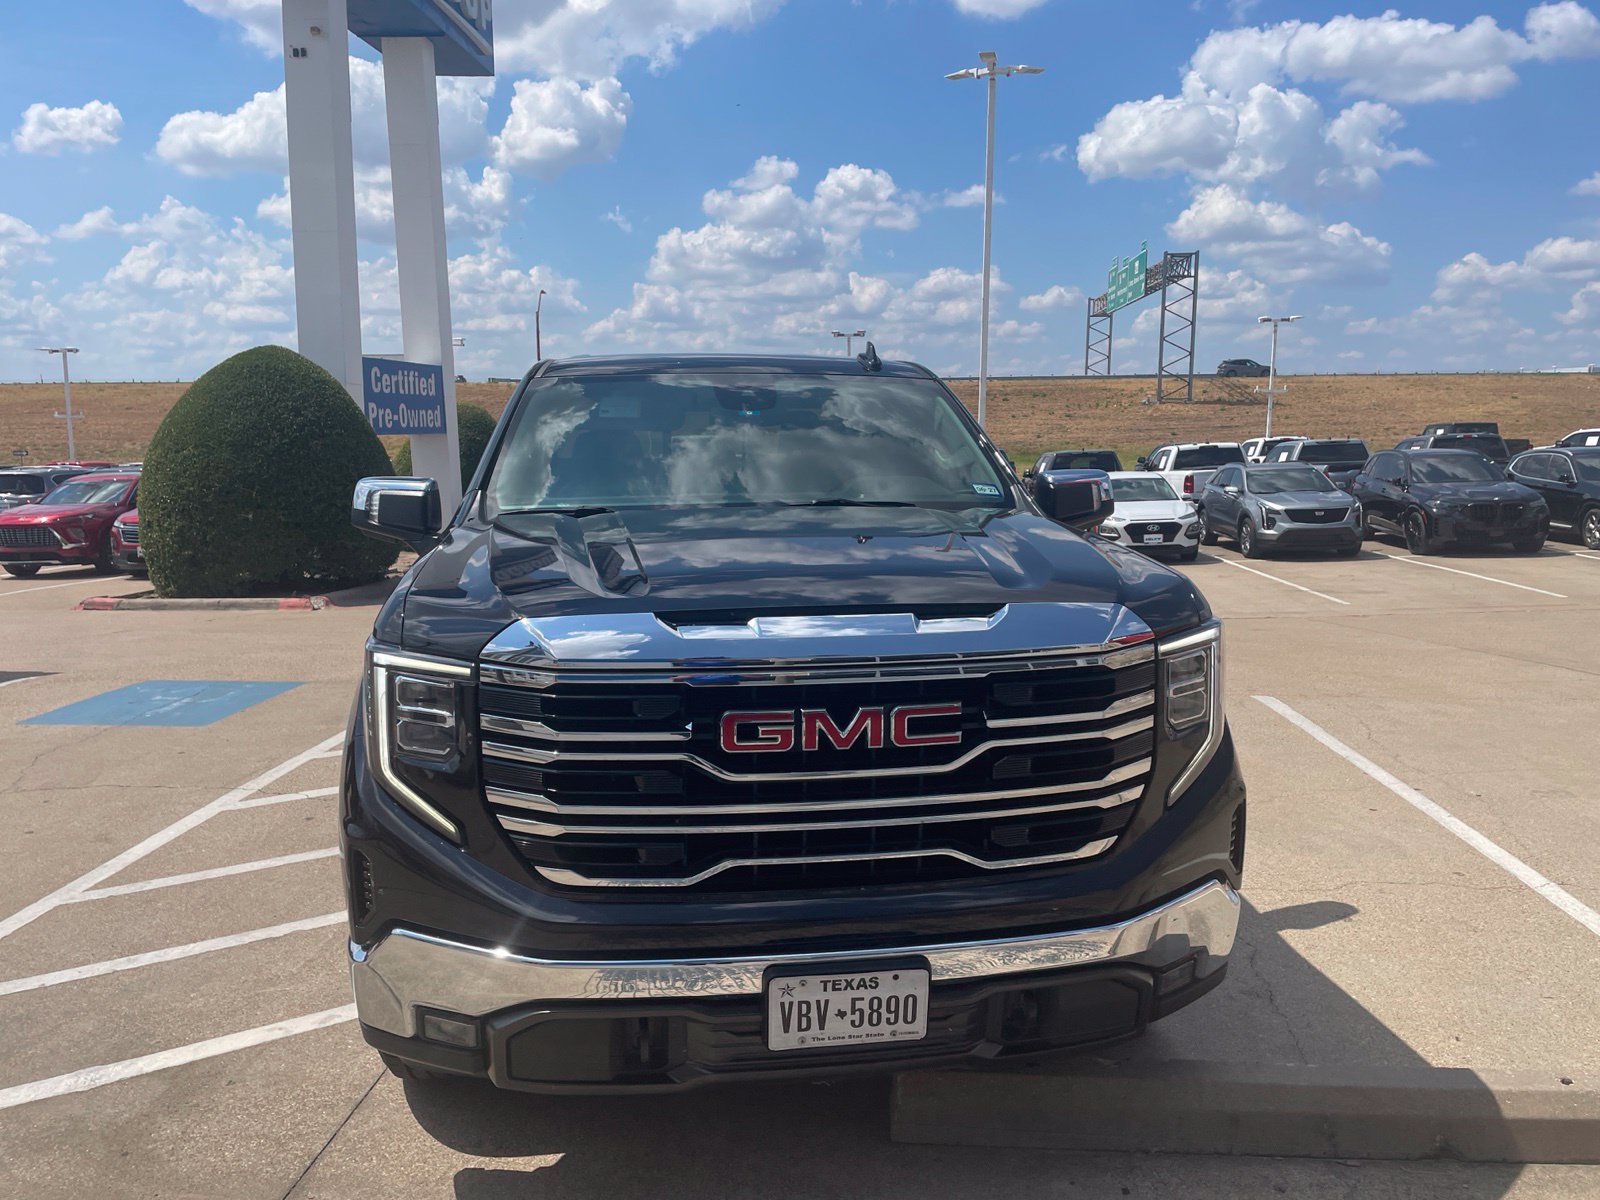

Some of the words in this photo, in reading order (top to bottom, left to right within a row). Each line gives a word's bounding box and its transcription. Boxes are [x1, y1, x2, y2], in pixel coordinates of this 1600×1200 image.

[370, 366, 436, 397] Certified
[368, 401, 442, 428] Pre-Owned
[720, 702, 962, 753] GMC
[820, 976, 879, 992] TEXAS
[779, 999, 830, 1034] VBV
[850, 994, 918, 1029] 5890
